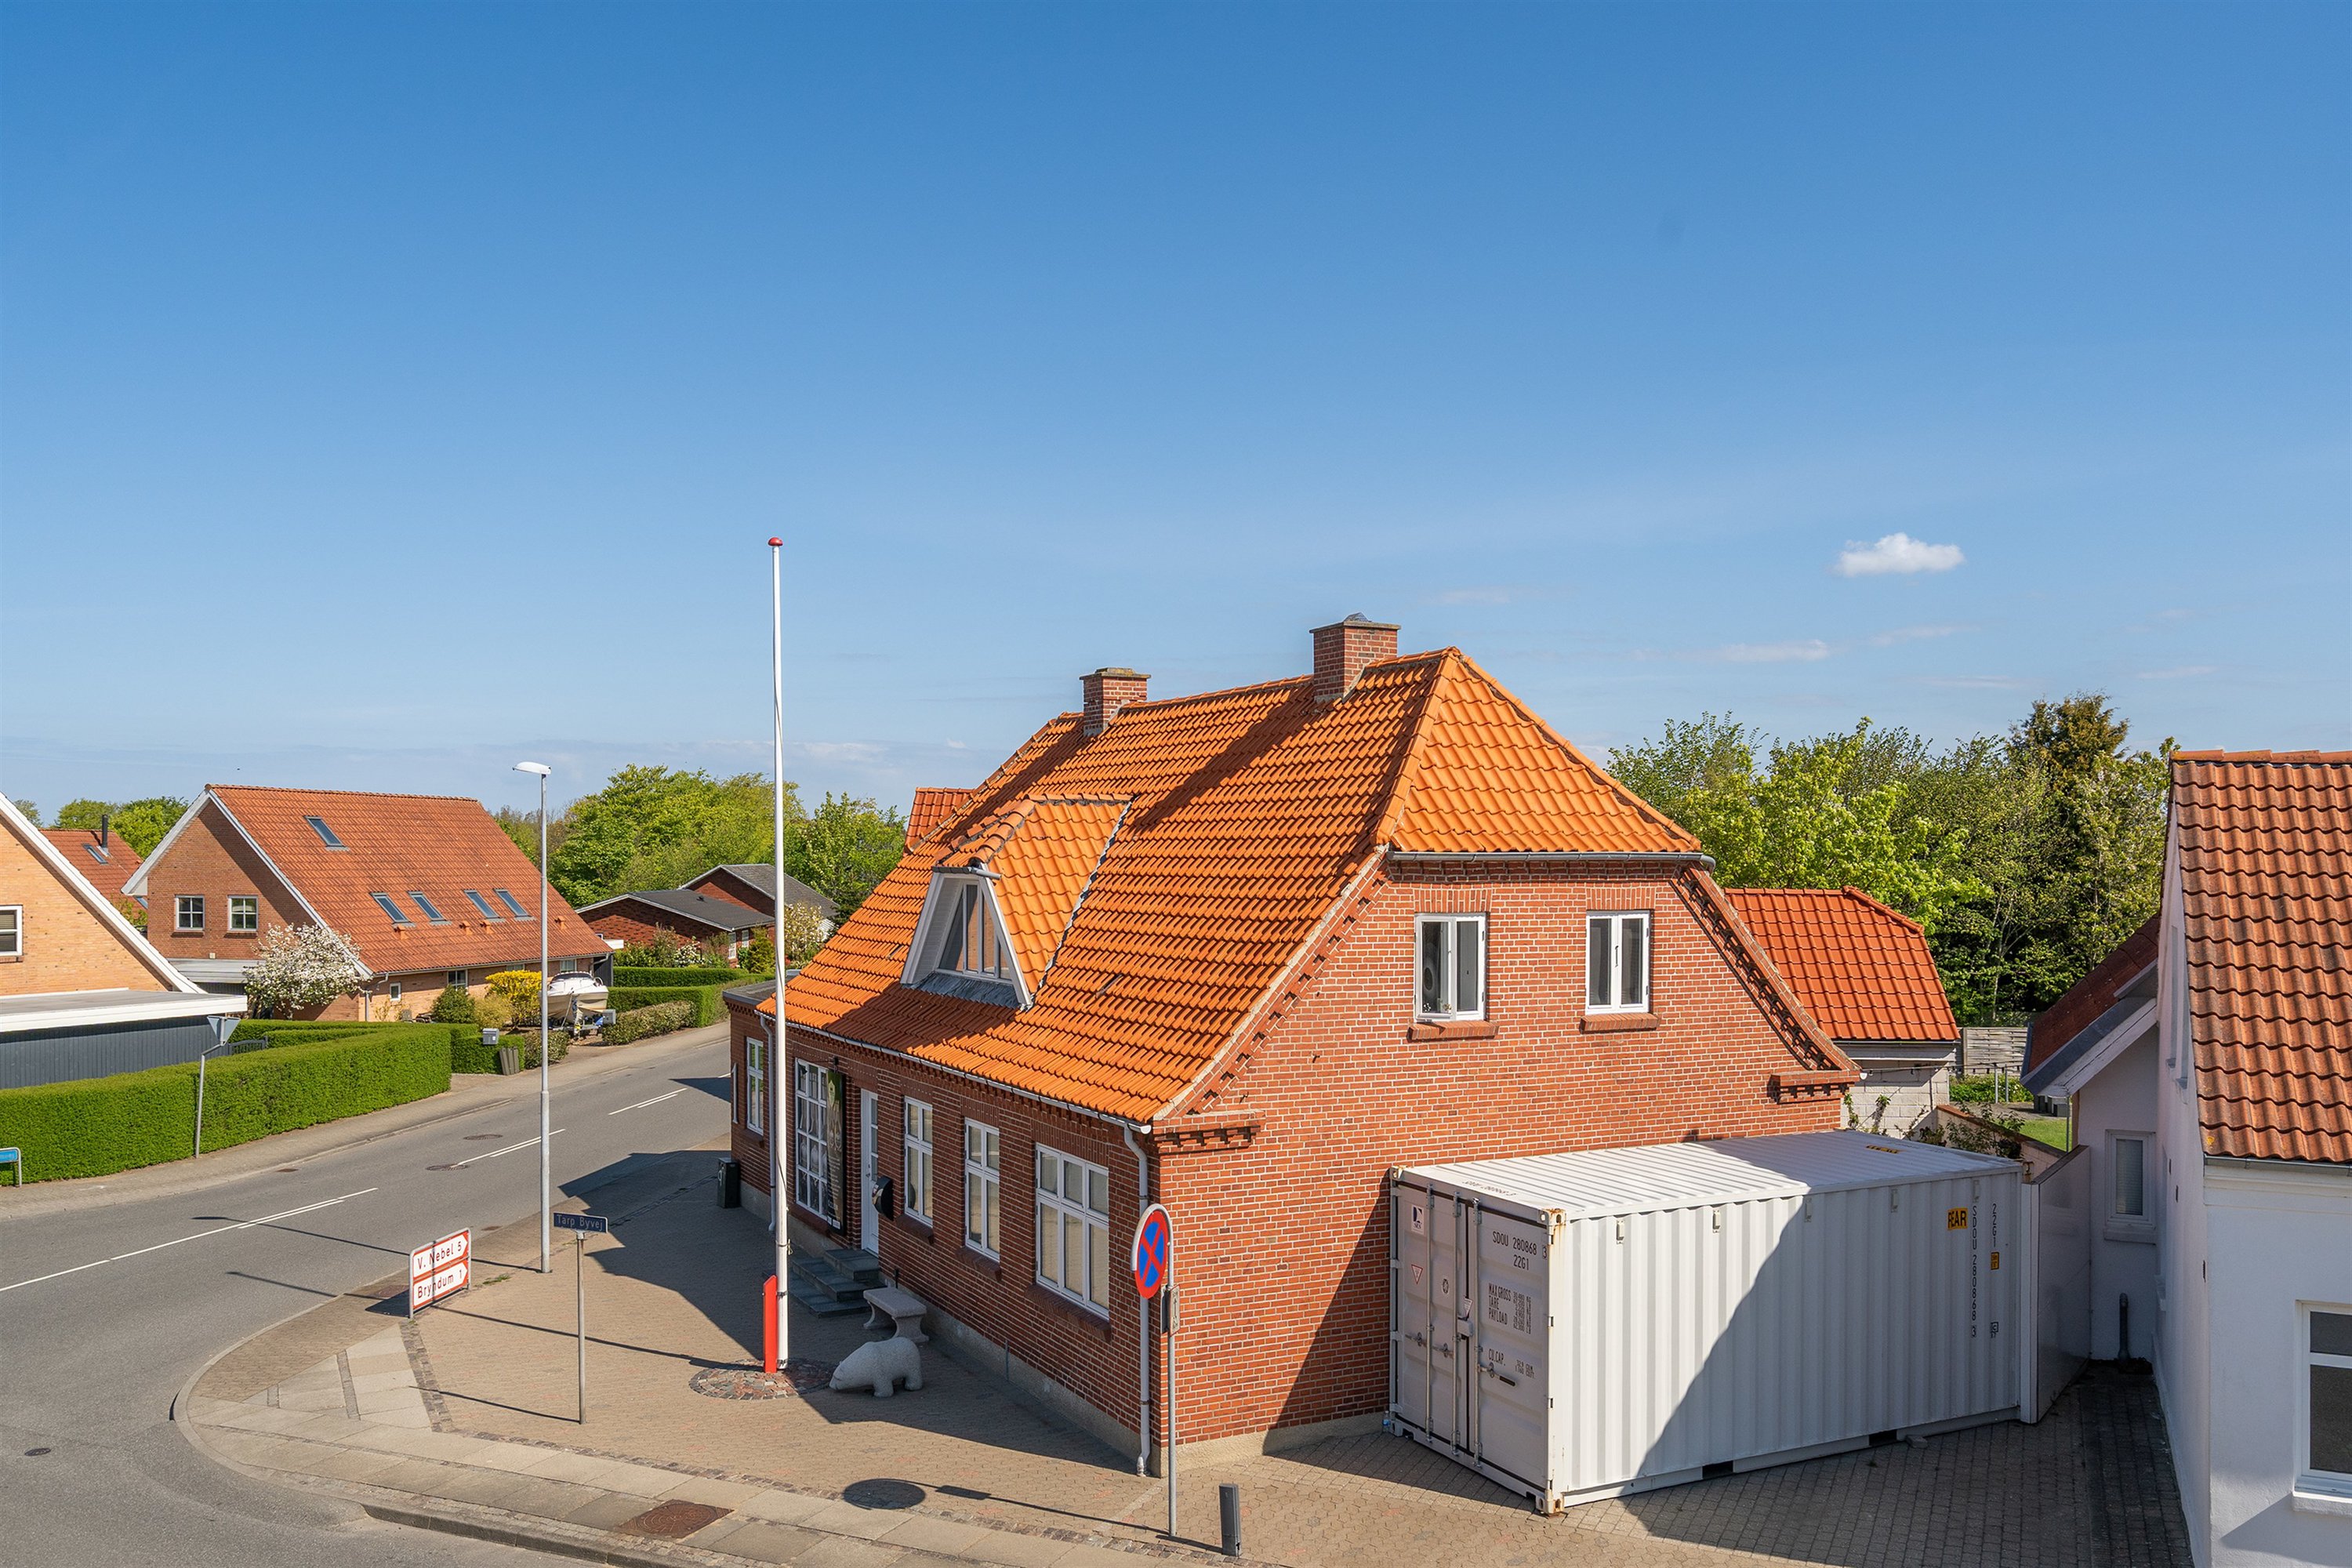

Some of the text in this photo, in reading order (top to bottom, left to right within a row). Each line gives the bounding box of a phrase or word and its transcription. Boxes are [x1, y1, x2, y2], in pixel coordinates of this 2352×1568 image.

[557, 1214, 603, 1232] Tarp Byvej
[417, 1241, 462, 1270] V. Nebel 5
[1492, 1231, 1548, 1259] SDOU 280868 3
[1513, 1254, 1530, 1271] 22G1
[418, 1269, 463, 1298] Bryndum 1
